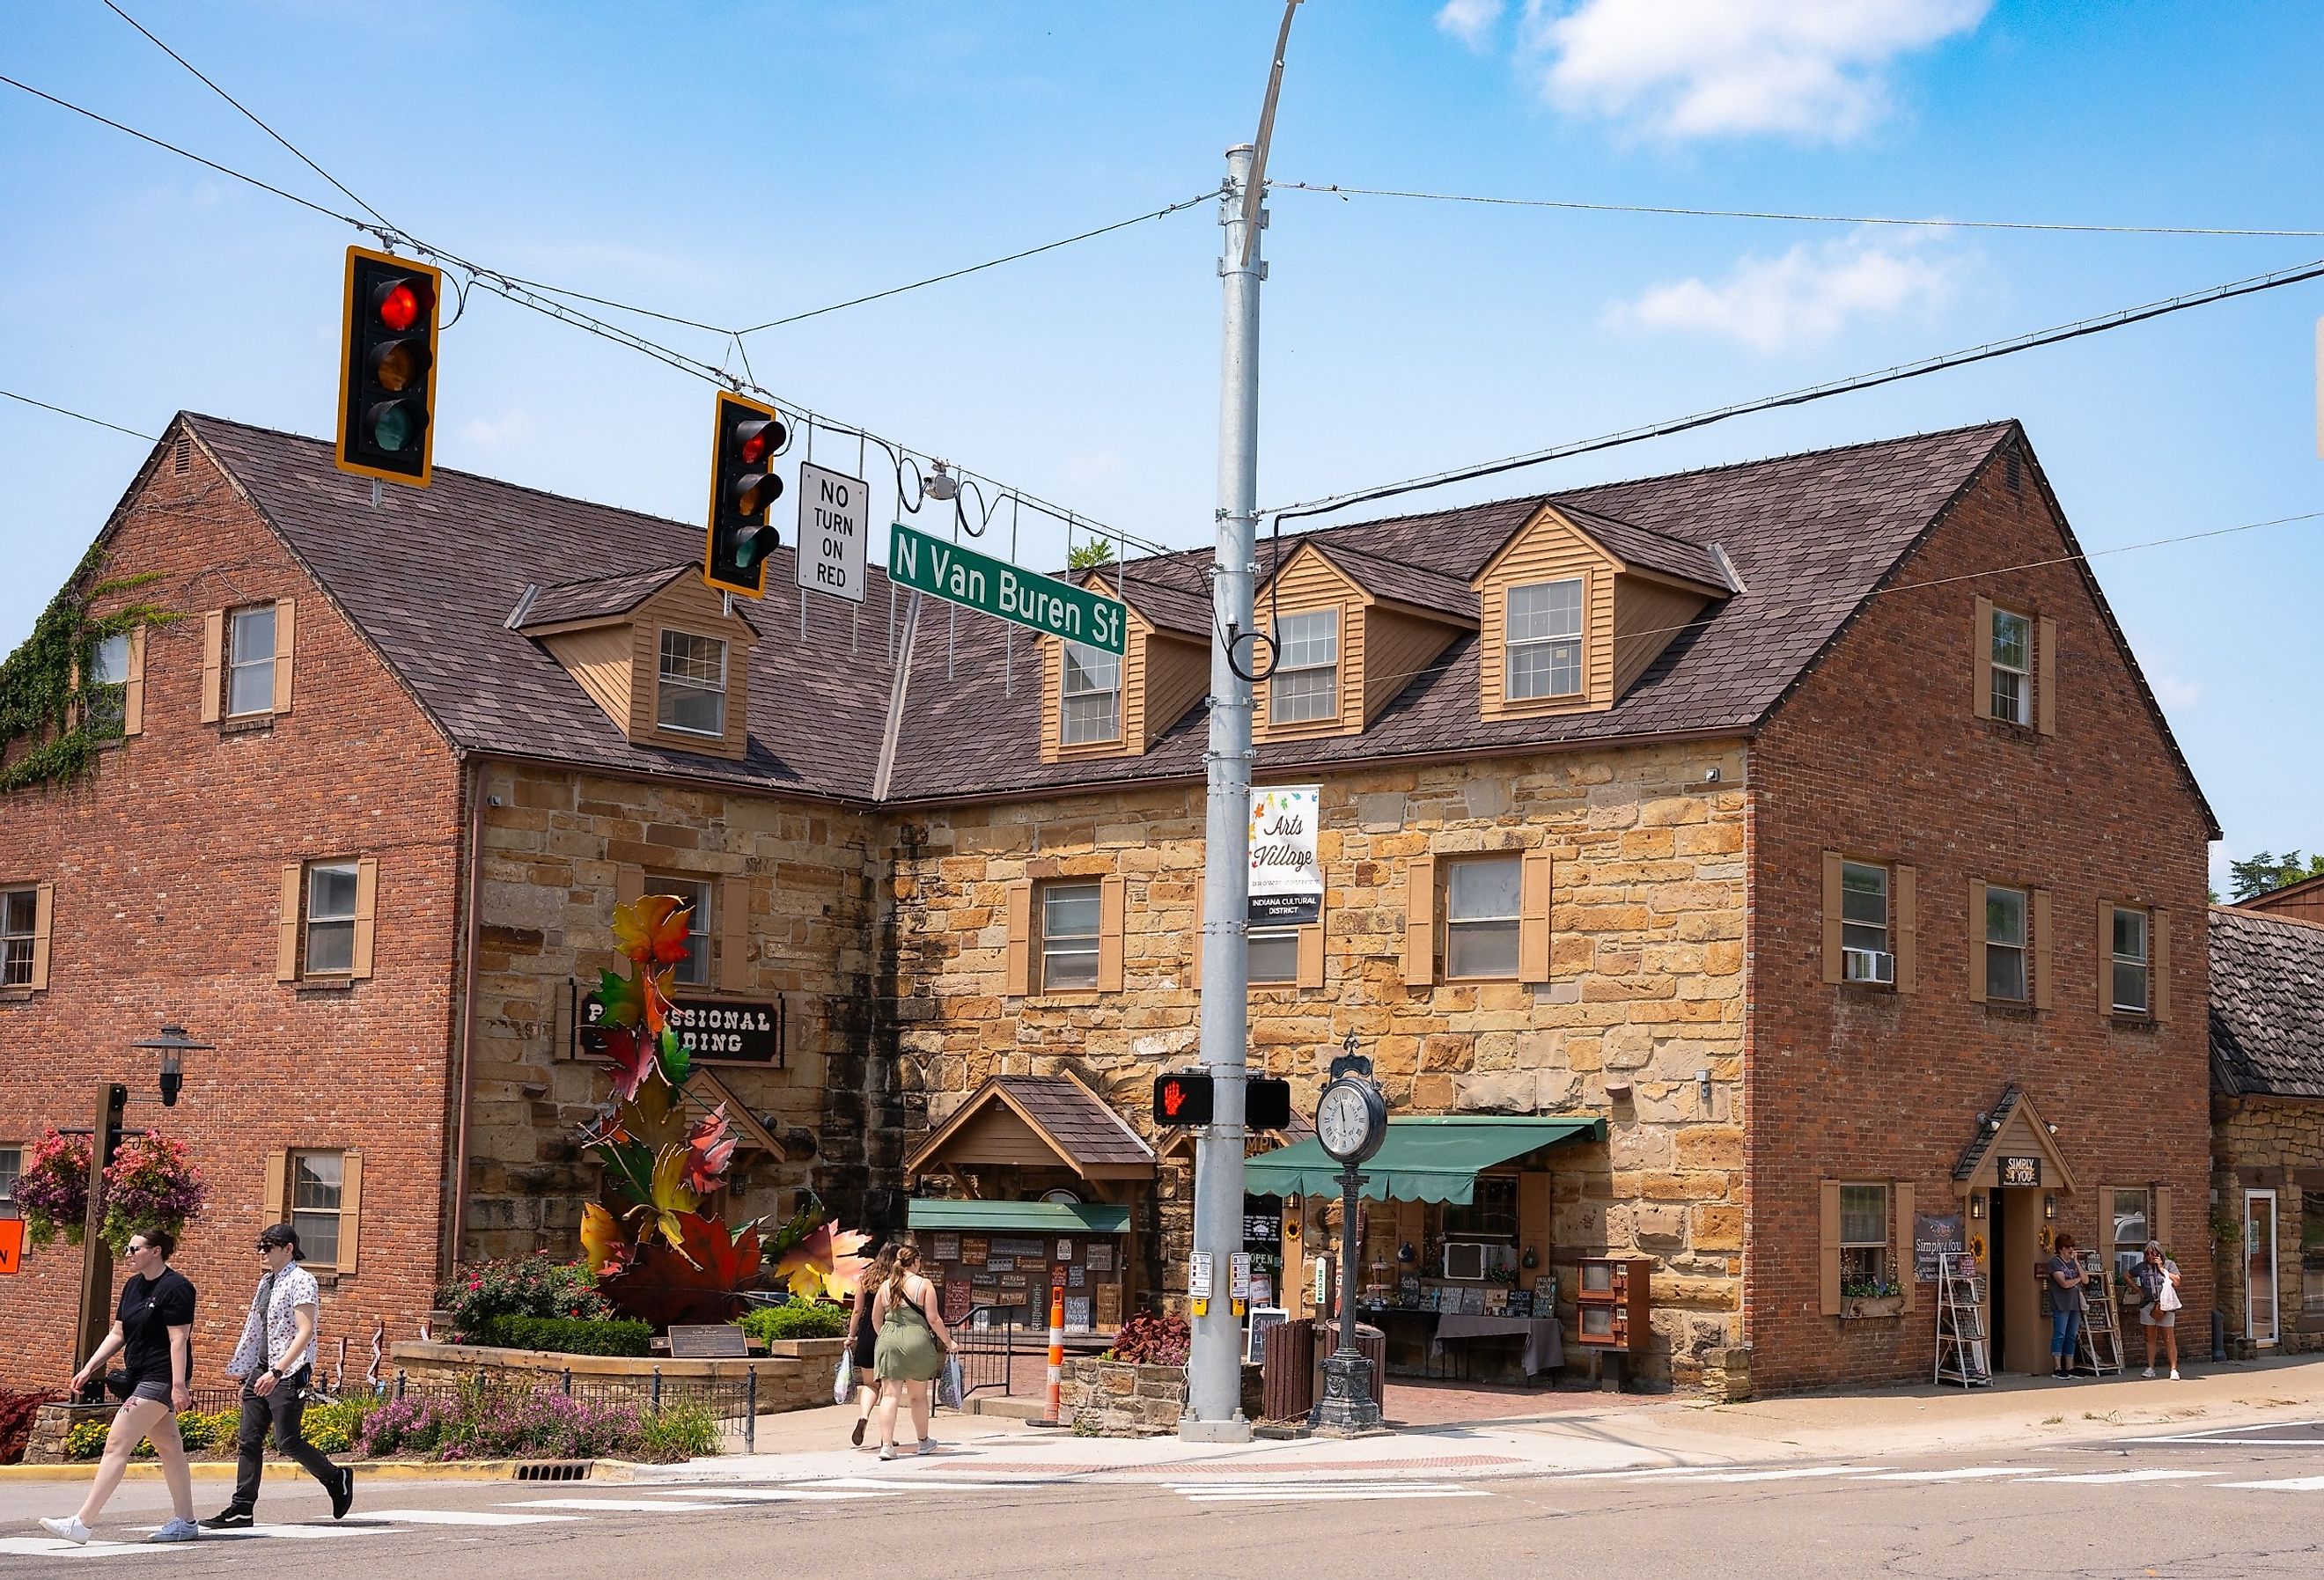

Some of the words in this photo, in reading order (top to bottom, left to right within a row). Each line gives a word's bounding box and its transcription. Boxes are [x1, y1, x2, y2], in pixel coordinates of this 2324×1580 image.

[820, 478, 849, 509] NO
[814, 507, 853, 538] TURN
[821, 537, 843, 562] ON
[816, 562, 846, 589] RED
[896, 533, 917, 580] N
[930, 543, 987, 604] Van
[999, 570, 1082, 636] Buren
[1092, 604, 1120, 648] St
[1263, 814, 1304, 836] Arts
[1254, 843, 1313, 872] Village
[1252, 898, 1281, 907] INDIANA
[1282, 896, 1317, 906] CULTURAL
[1269, 906, 1298, 915] DISTRICT
[588, 1003, 771, 1032] PSSIONAL
[2007, 1157, 2034, 1170] SIMPLY
[2017, 1170, 2033, 1182] YOU
[1916, 1238, 1944, 1255] Simply
[1948, 1238, 1961, 1252] You
[1249, 1253, 1273, 1265] OPEN
